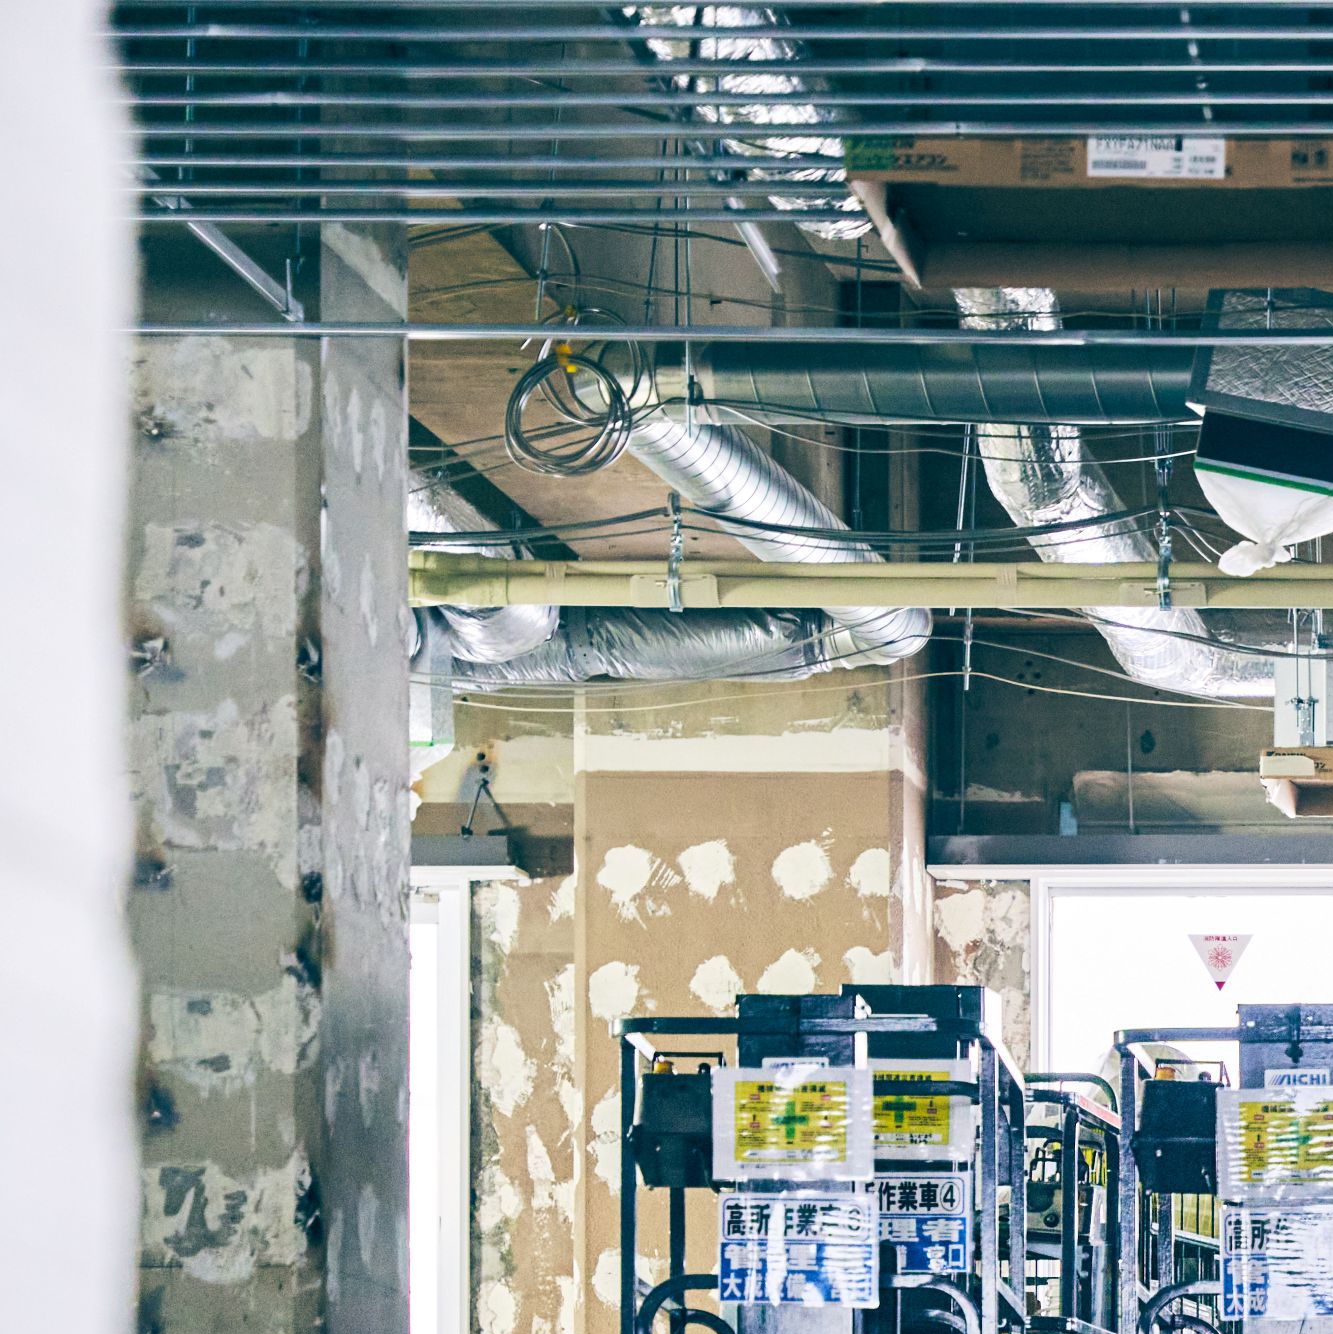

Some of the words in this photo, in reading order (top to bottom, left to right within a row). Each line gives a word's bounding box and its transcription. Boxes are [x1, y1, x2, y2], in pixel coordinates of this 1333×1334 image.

[1269, 1073, 1326, 1086] AICHI
[866, 1180, 960, 1212] 作業車④
